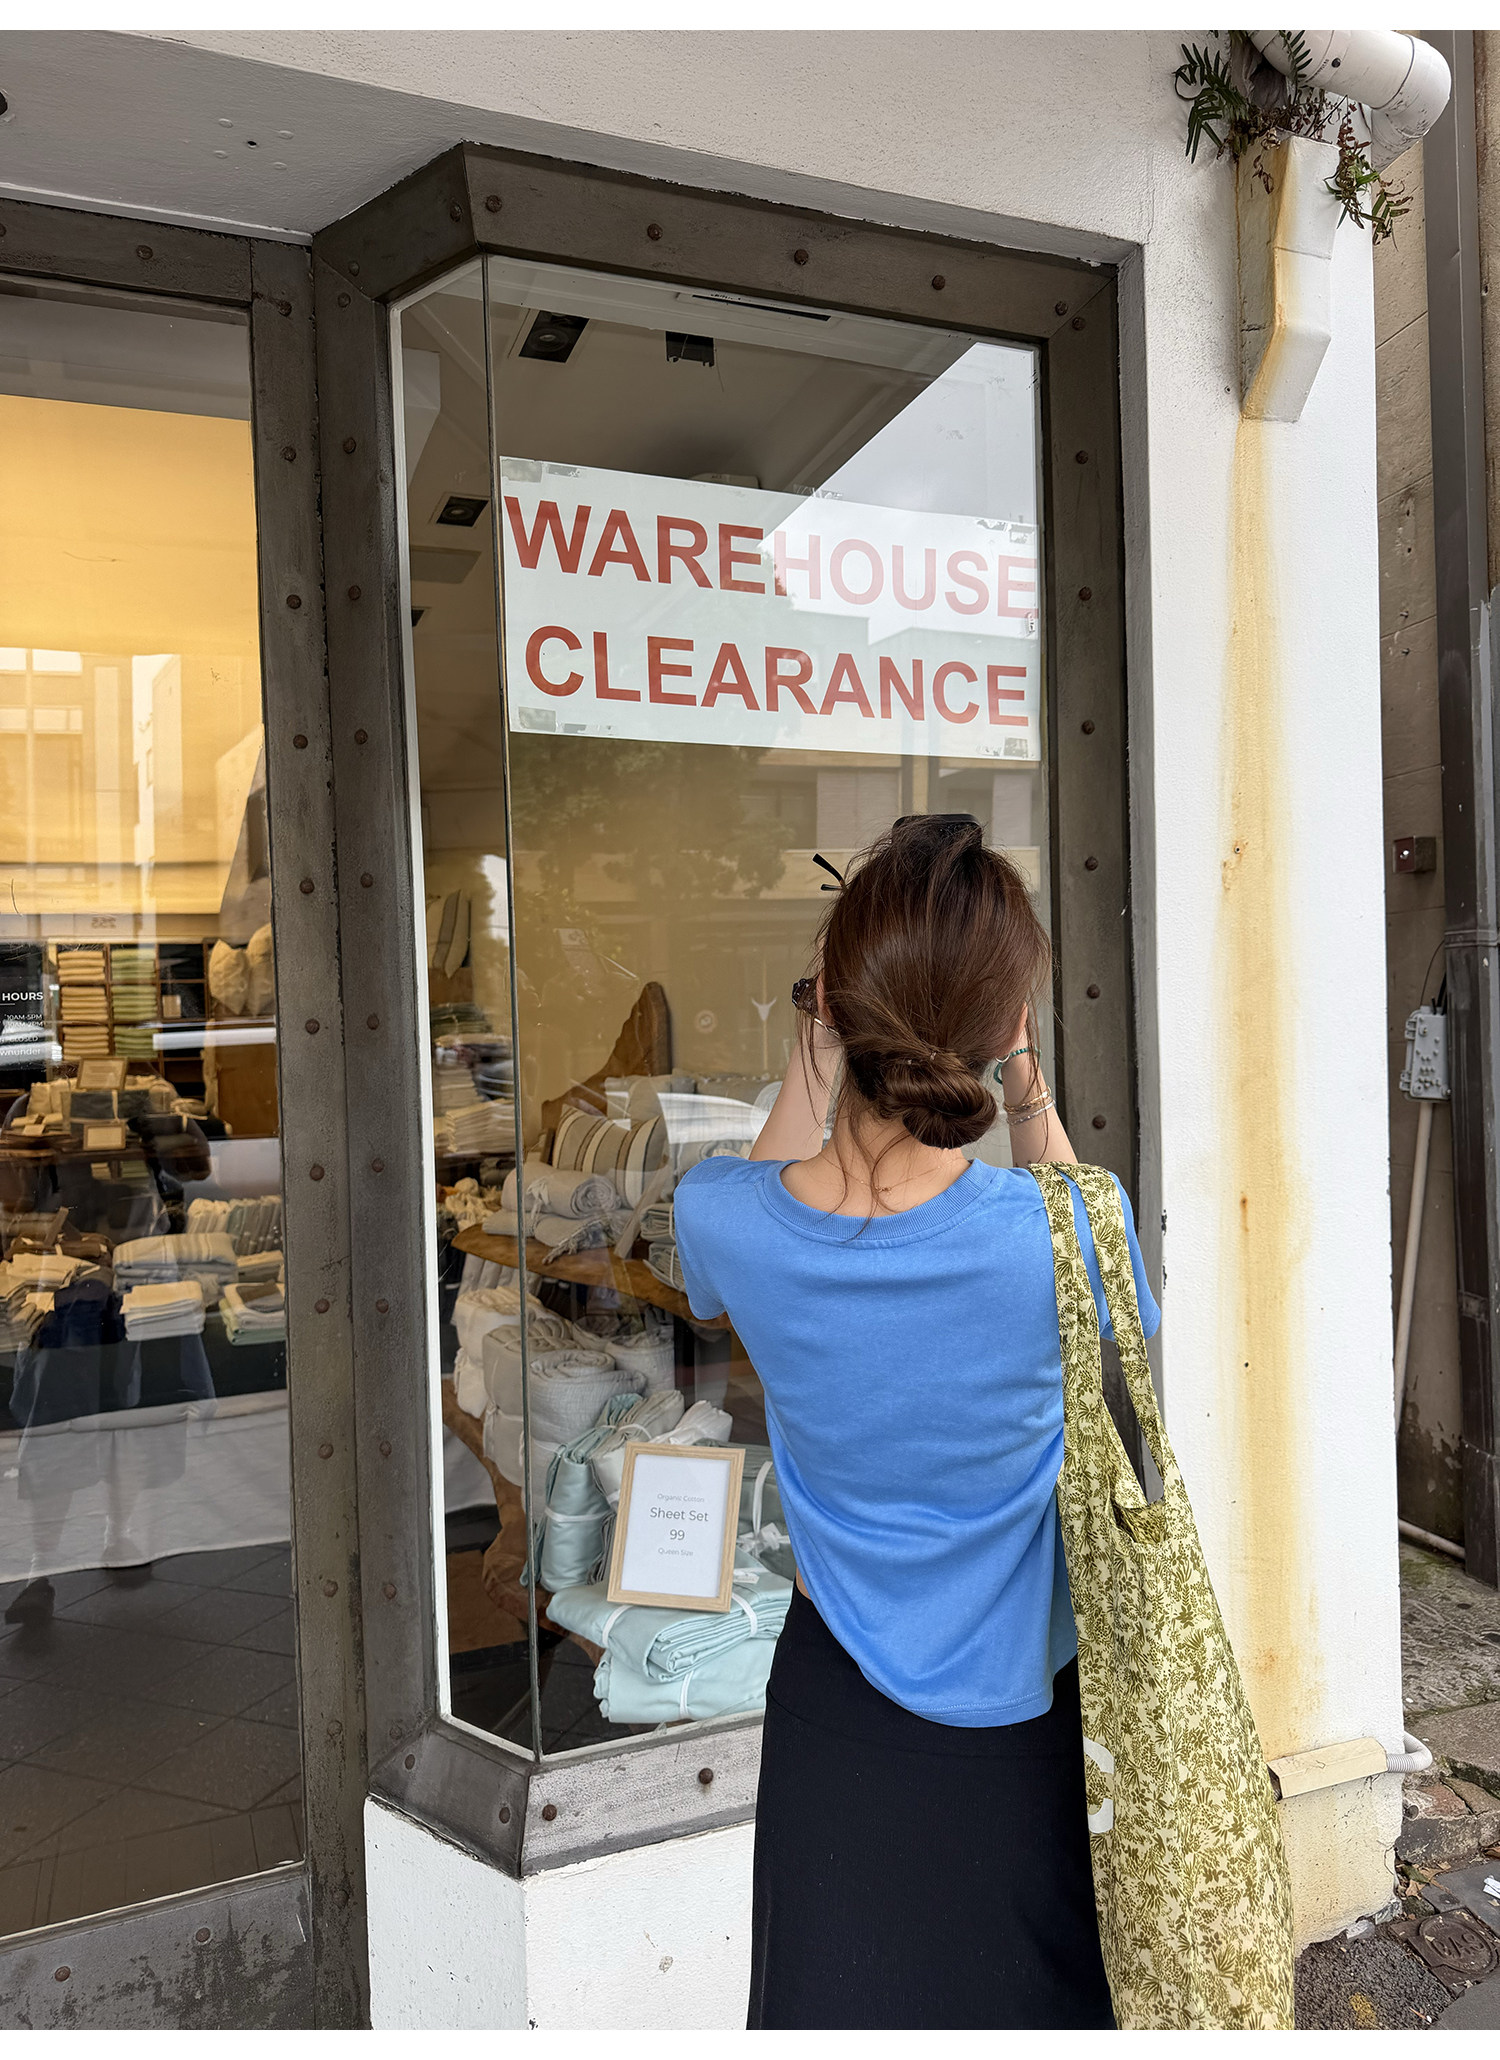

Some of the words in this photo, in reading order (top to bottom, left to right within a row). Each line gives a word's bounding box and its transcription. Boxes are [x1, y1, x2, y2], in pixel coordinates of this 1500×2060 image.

[503, 496, 1039, 619] WAREHOUSE
[525, 625, 1029, 727] CLEARANCE
[2, 992, 44, 1001] HOURS
[657, 1493, 682, 1502] Organic
[683, 1495, 705, 1503] Cotton
[650, 1507, 685, 1520] Sheet
[689, 1510, 709, 1522] Set
[669, 1529, 685, 1541] 99
[658, 1547, 679, 1556] Queen
[681, 1549, 694, 1557] Size
